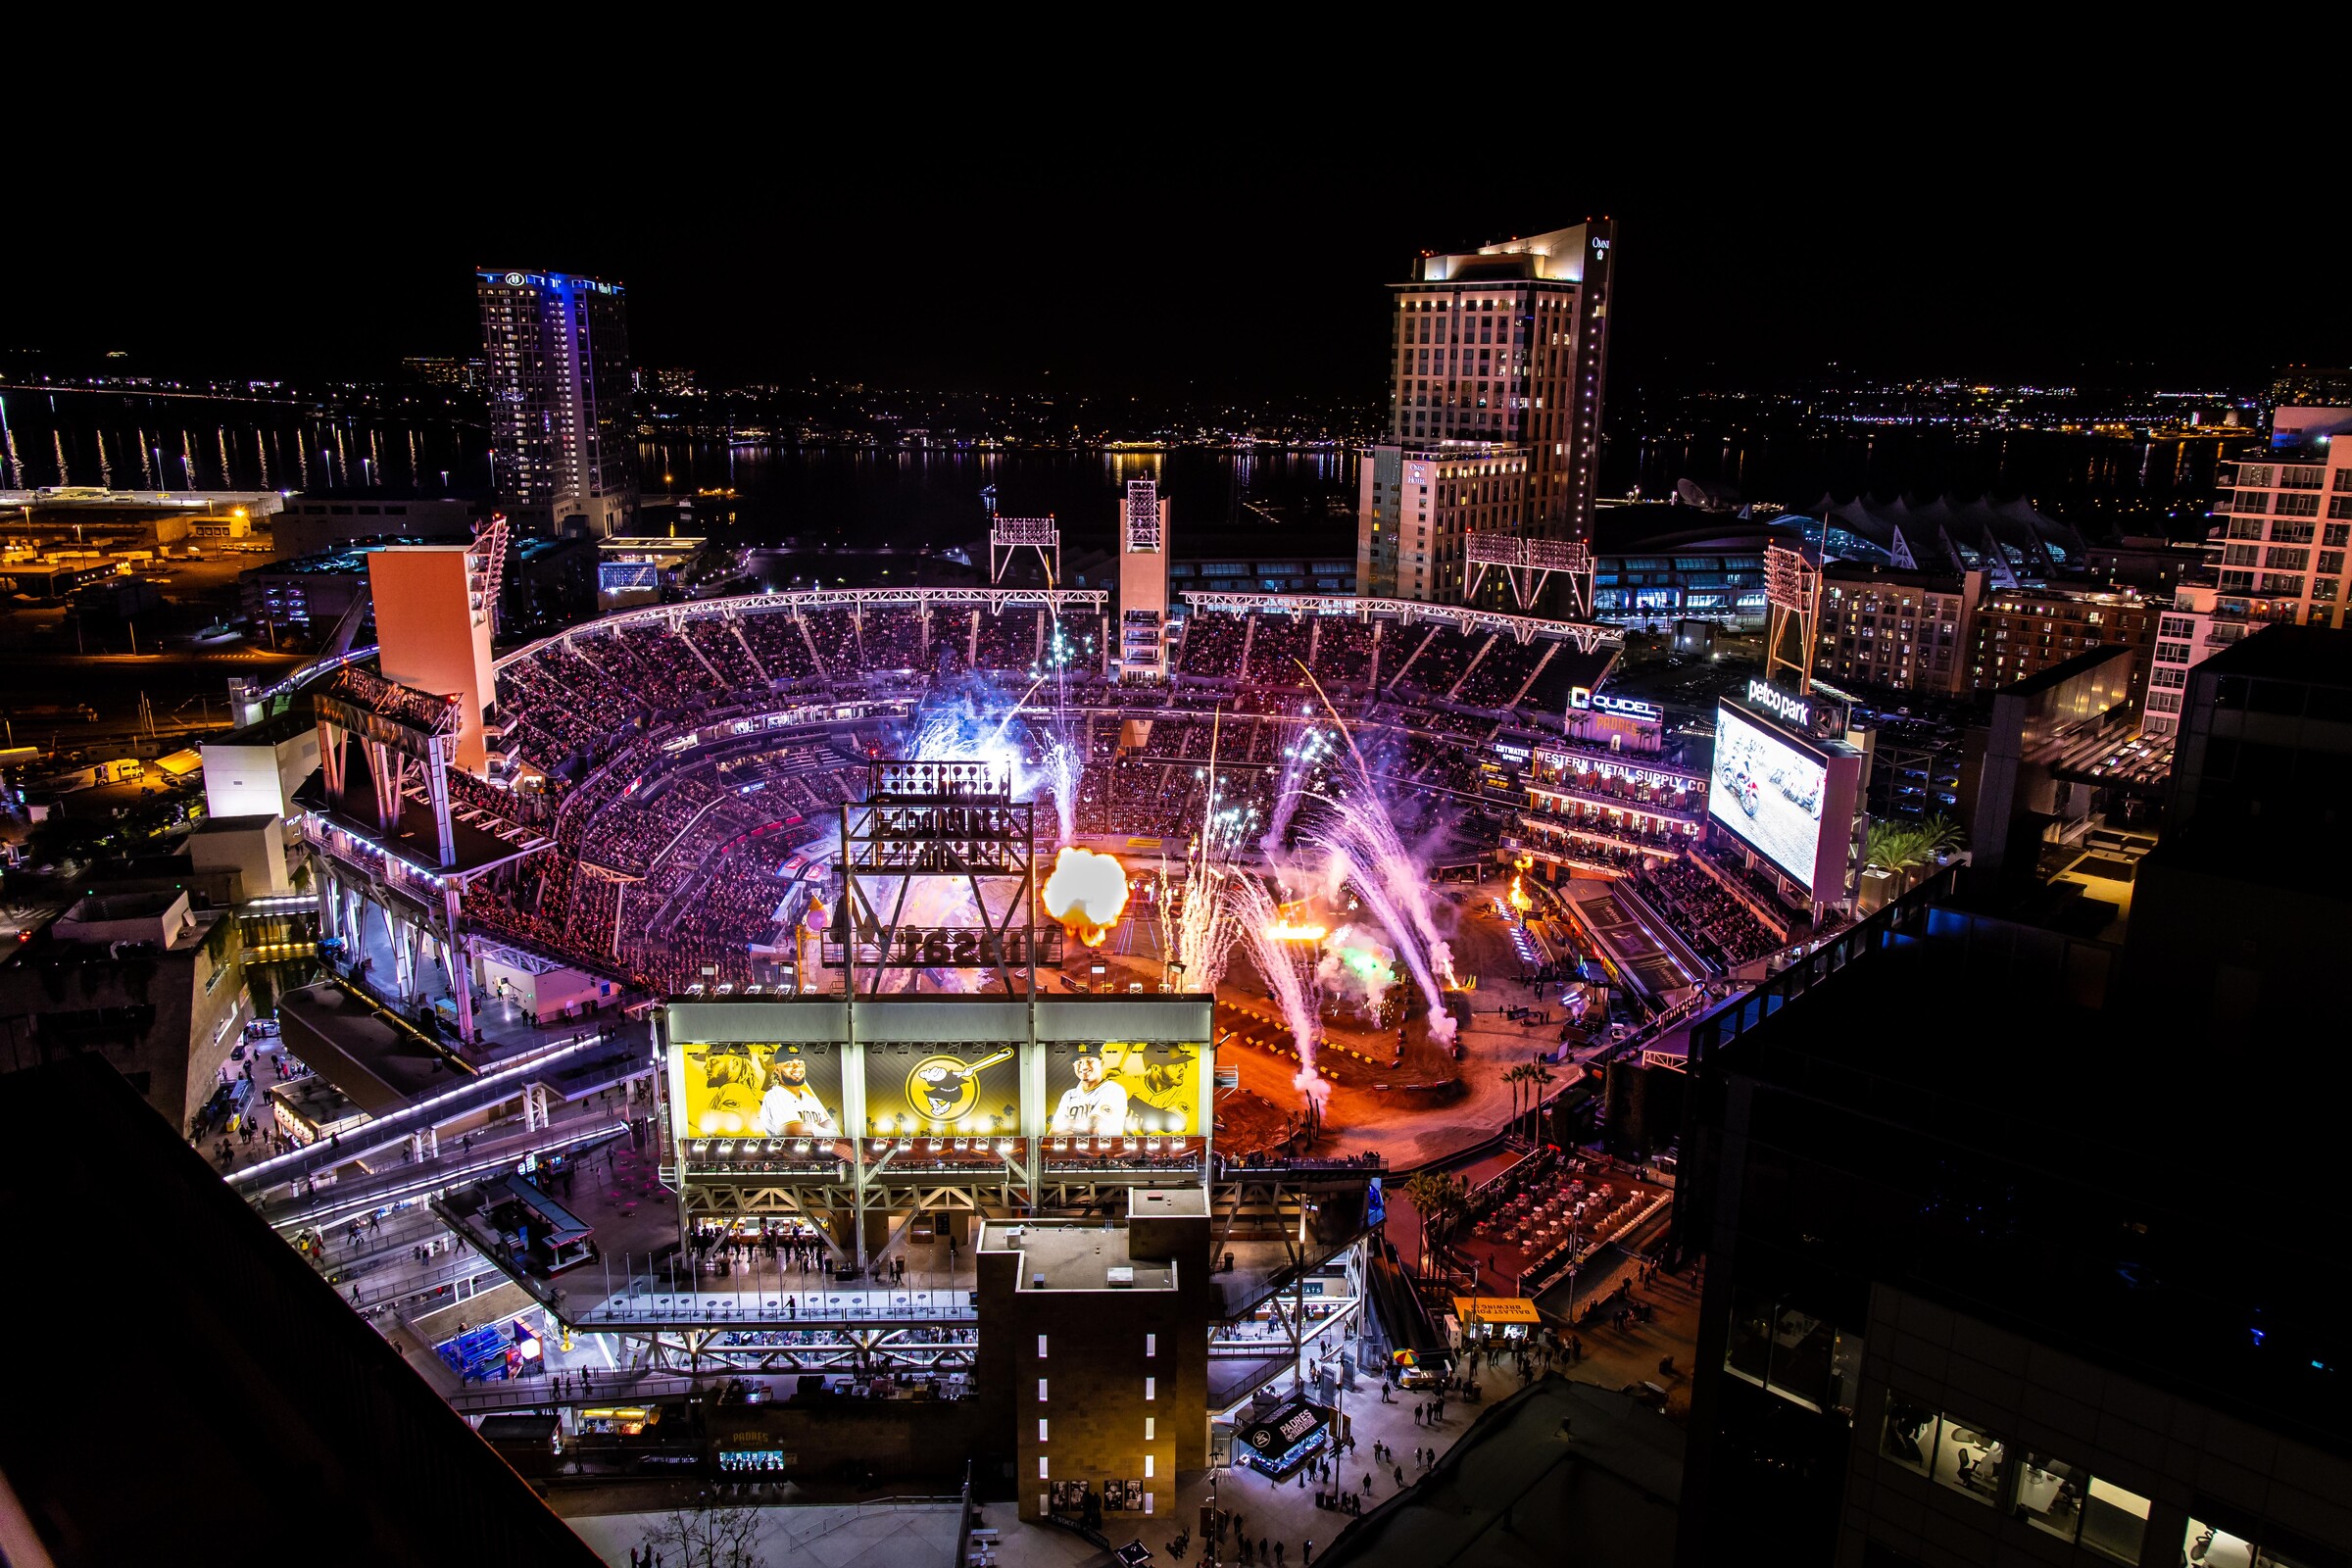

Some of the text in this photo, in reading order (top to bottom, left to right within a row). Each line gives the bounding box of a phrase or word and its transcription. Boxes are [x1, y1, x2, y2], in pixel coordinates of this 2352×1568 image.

[1592, 695, 1656, 715] QUIDEL
[1748, 679, 1809, 726] petco park
[1596, 716, 1638, 737] PADRES
[1536, 750, 1709, 795] WESTERN METAL SUPPLY CO.
[1279, 1409, 1312, 1437] PADRES
[733, 1432, 768, 1443] PADRES
